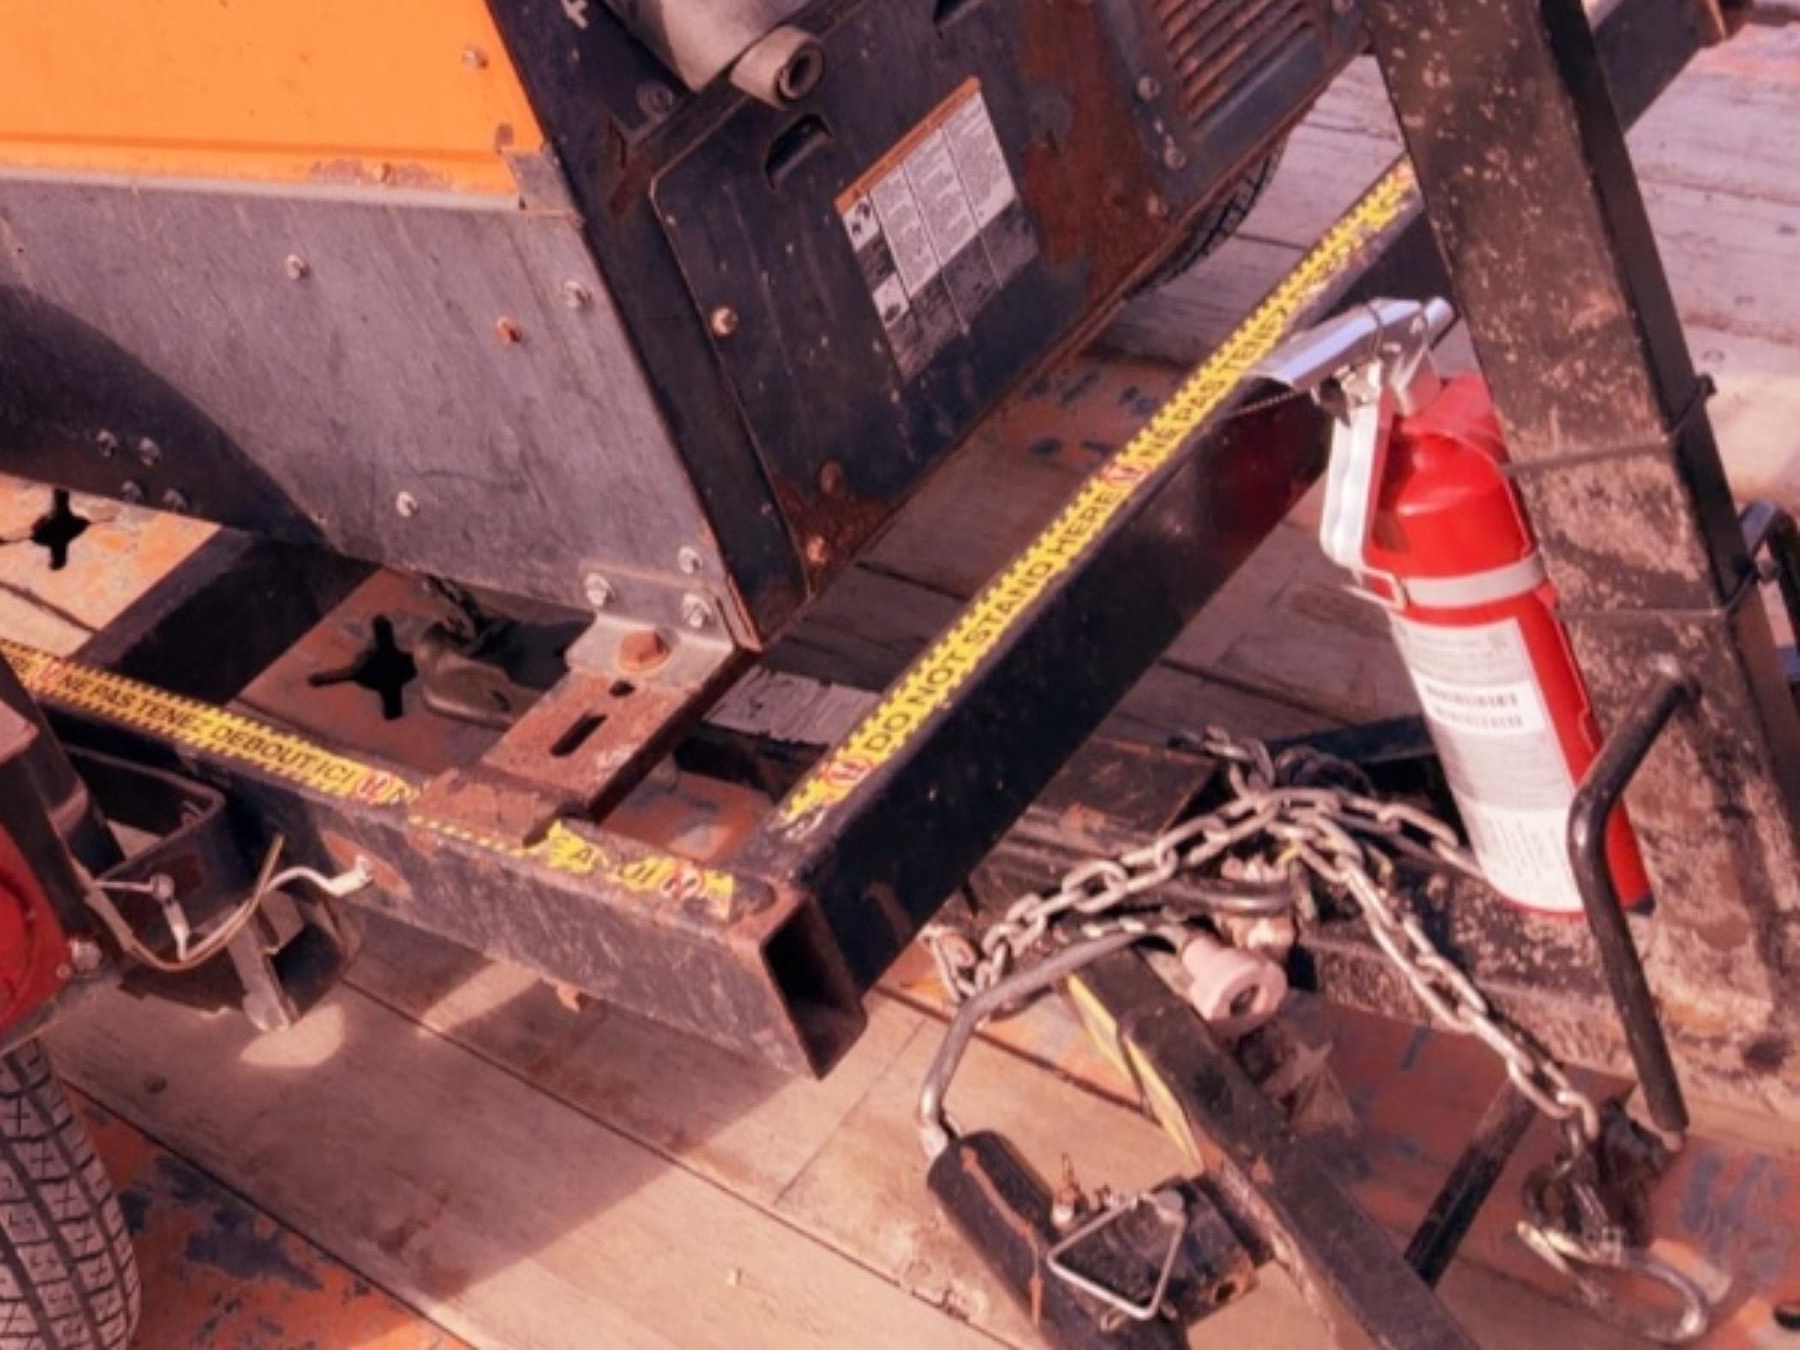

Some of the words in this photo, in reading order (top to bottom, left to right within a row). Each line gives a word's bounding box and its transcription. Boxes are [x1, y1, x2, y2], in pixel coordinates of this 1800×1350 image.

[864, 712, 911, 752] DO
[906, 651, 967, 706] NOT
[962, 561, 1051, 646] STAND
[1046, 490, 1119, 555] HERE
[210, 725, 320, 770] DEBOUT
